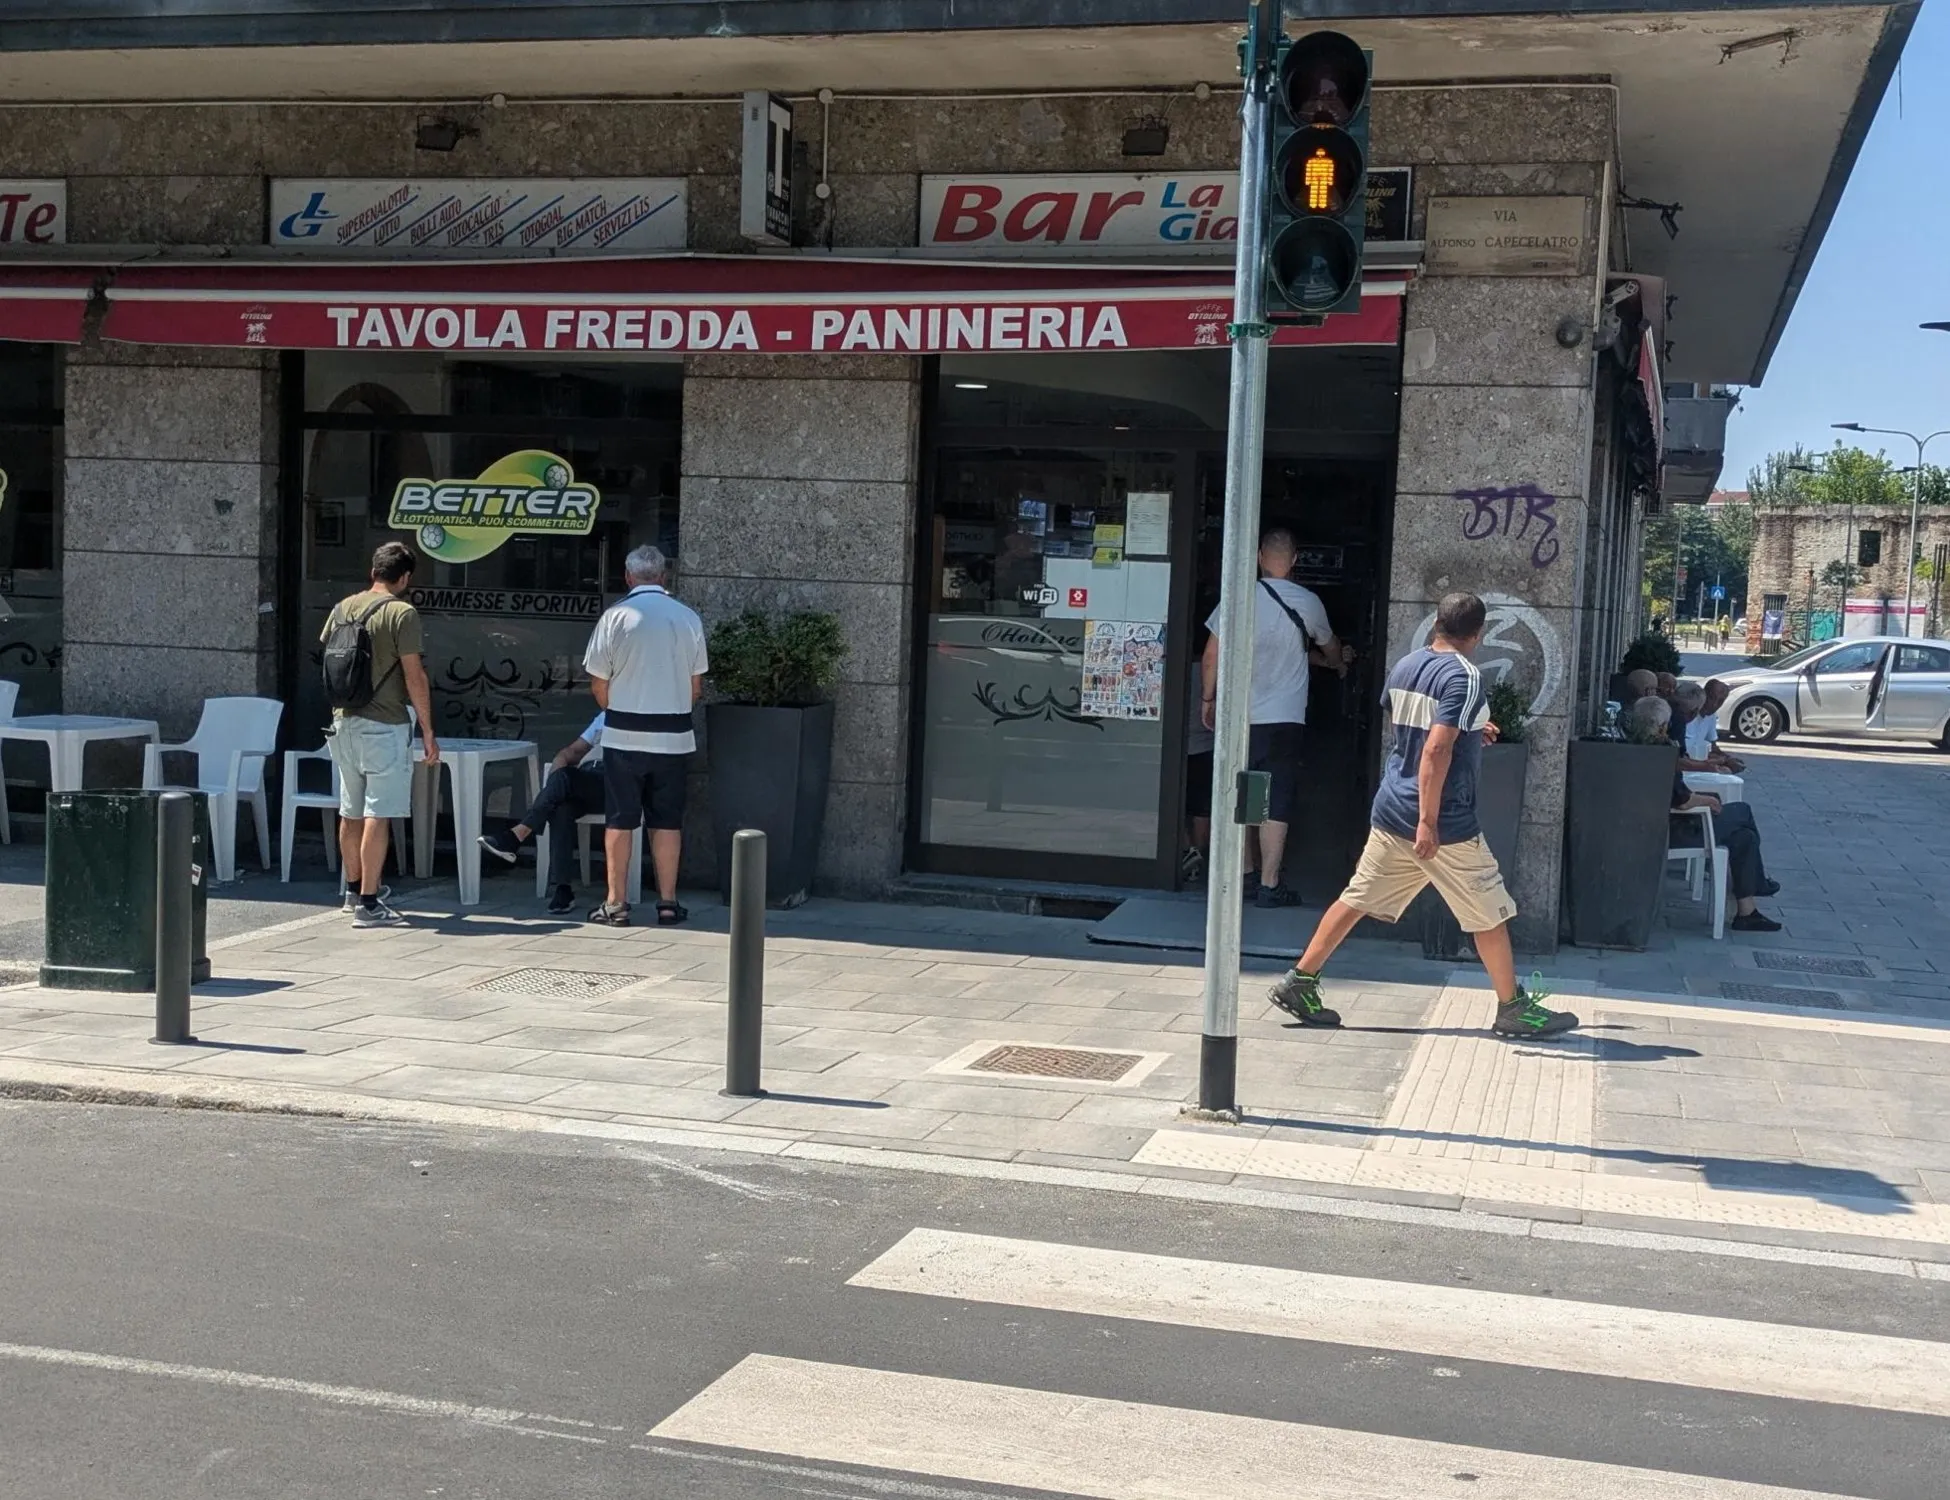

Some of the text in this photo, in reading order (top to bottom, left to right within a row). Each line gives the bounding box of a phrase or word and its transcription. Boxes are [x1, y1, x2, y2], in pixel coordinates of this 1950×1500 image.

[769, 101, 791, 198] T
[1160, 181, 1225, 208] La
[336, 184, 410, 244] SUPERENALOTTO
[374, 215, 402, 244] LOTTO
[410, 198, 462, 244] BOLLI AUTO
[447, 197, 500, 244] TOTOCALCIO
[519, 205, 564, 246] TOTOGOAL
[556, 199, 608, 246] BIG MATCH
[593, 195, 650, 247] SERVIZI LIS
[932, 184, 1146, 242] Bar
[1159, 210, 1239, 241] Gia
[1493, 210, 1517, 222] VIA
[483, 219, 505, 245] TRIS
[1430, 236, 1579, 249] ALFONSO CAPECELATRO
[327, 306, 1128, 350] TAVOLA FREDDA - PANINERIA
[399, 486, 593, 515] BETTER
[393, 512, 401, 523] È
[479, 516, 505, 527] PUOI
[506, 518, 588, 530] SCOMMETTERCI
[407, 588, 599, 615] OMMESSE SPORTIVE
